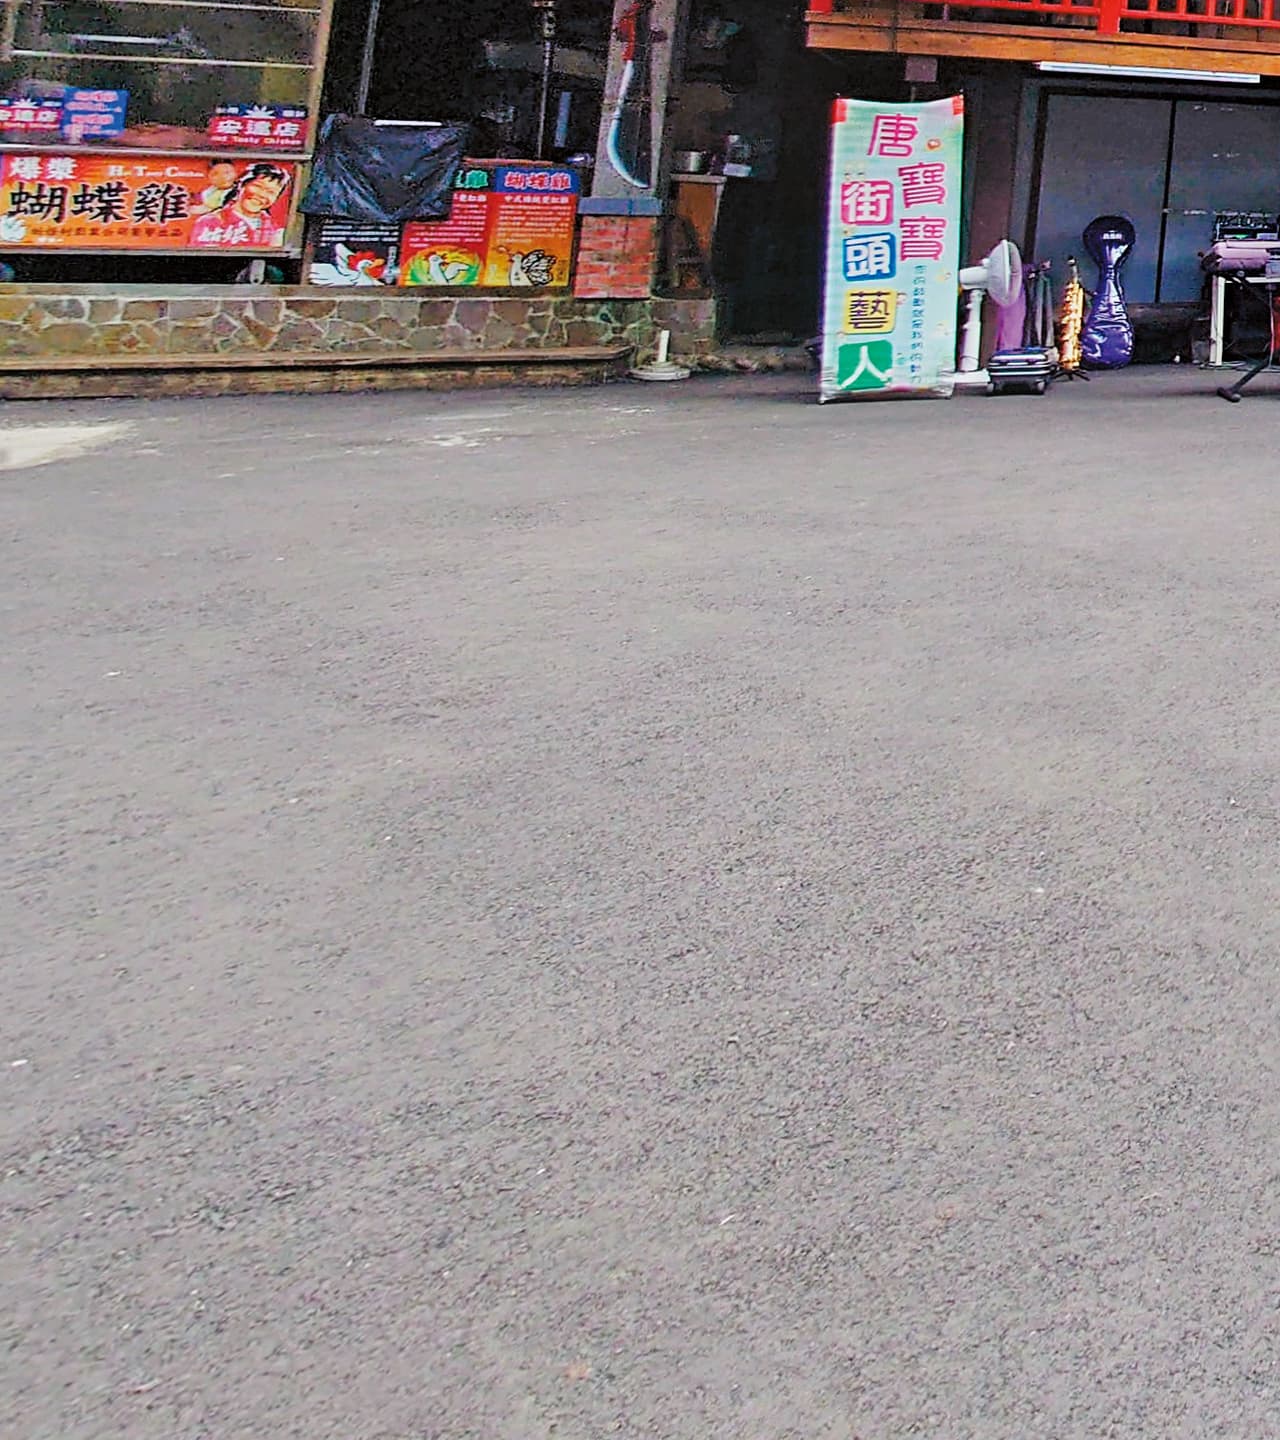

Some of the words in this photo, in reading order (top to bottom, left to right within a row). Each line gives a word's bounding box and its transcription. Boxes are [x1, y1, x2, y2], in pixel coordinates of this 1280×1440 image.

[8, 182, 189, 224] 蝴蝶雞
[840, 181, 894, 389] 街頭藝人
